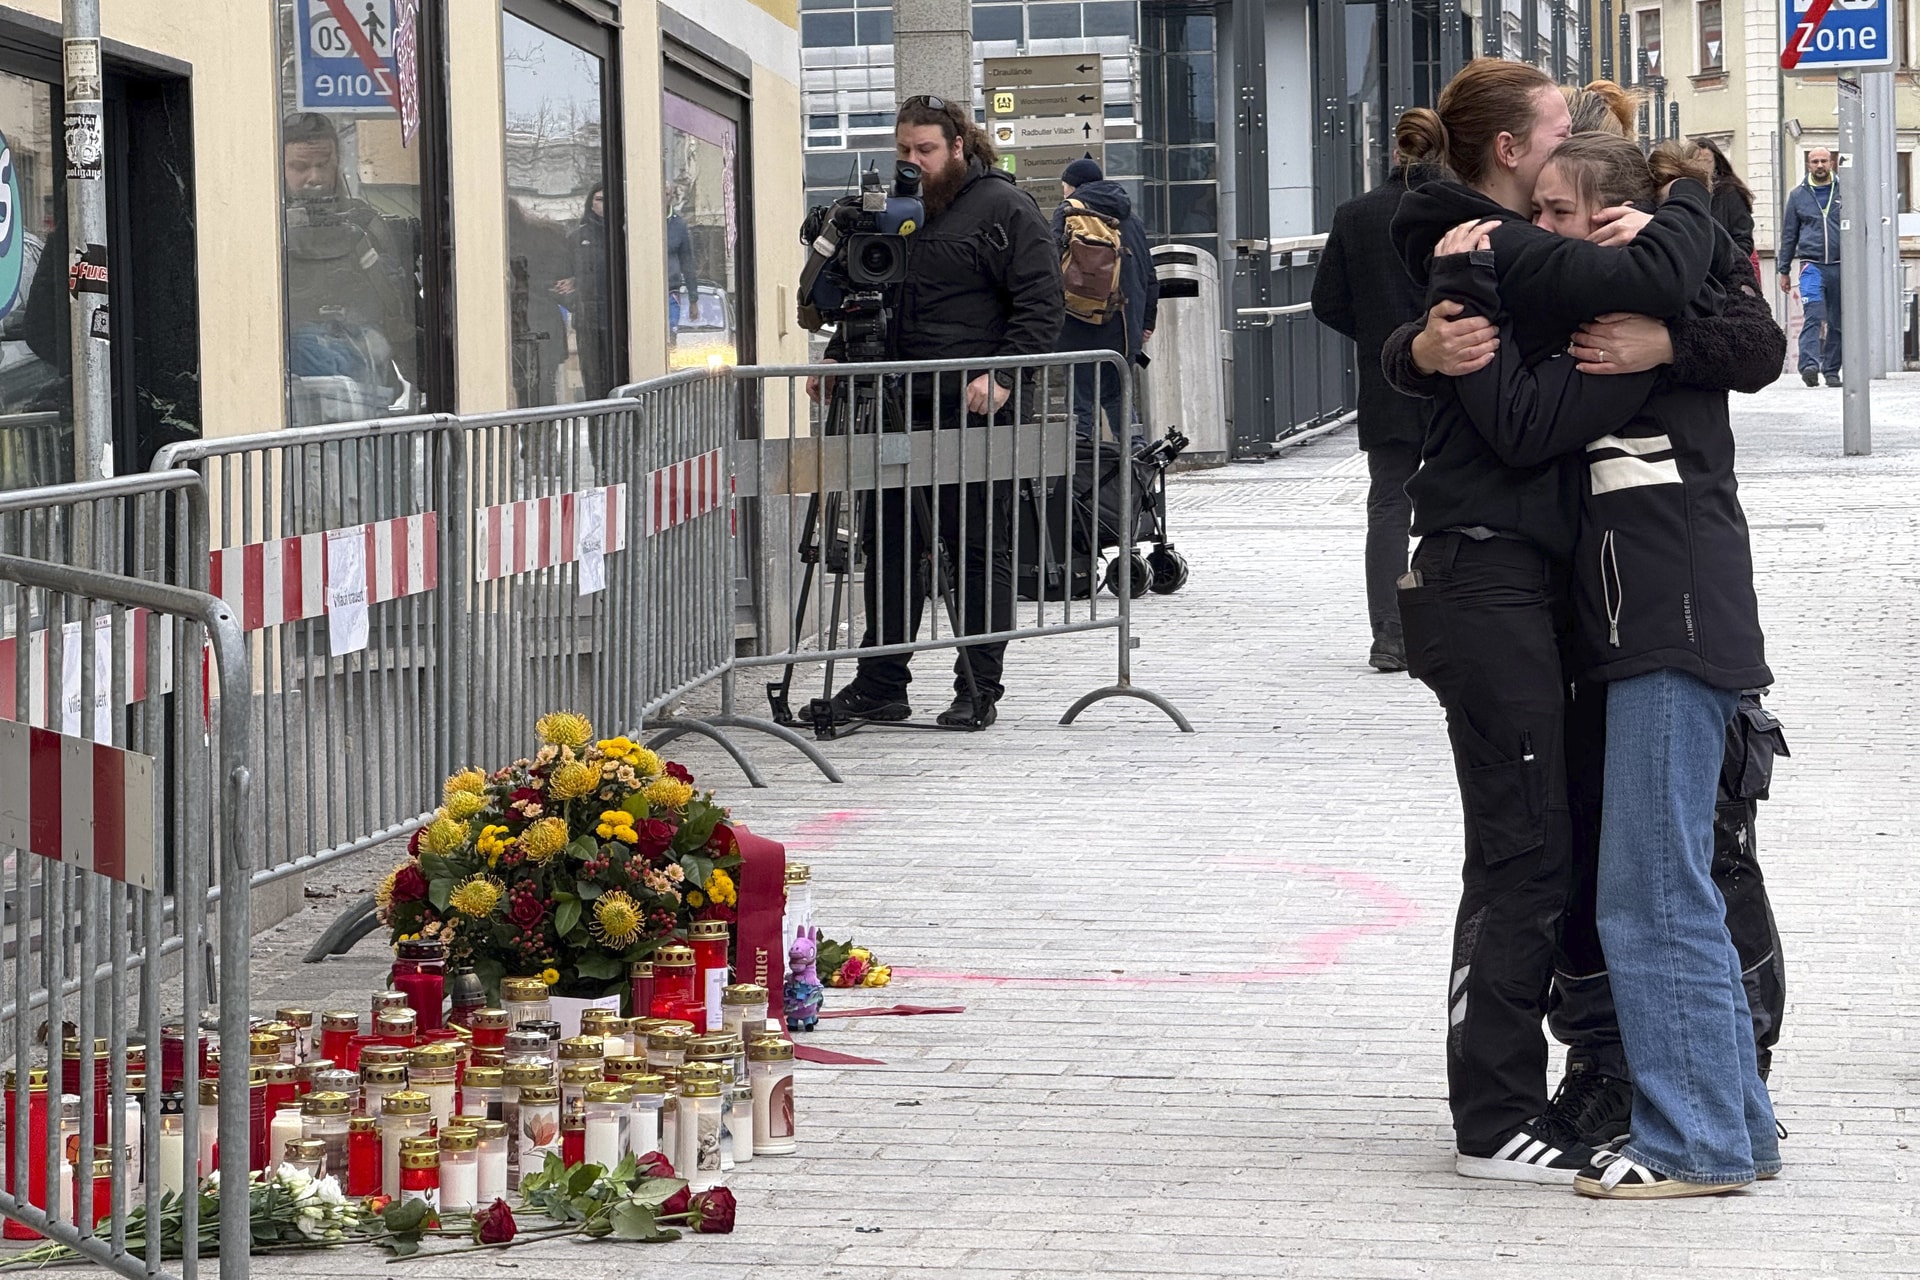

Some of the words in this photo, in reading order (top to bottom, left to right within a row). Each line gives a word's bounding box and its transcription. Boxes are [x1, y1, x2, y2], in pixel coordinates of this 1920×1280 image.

[1796, 22, 1877, 52] Zone
[992, 67, 1033, 77] Draulände
[1053, 127, 1075, 135] Villach
[1683, 593, 1695, 643] J.LINDEBERG
[754, 946, 768, 987] auer
